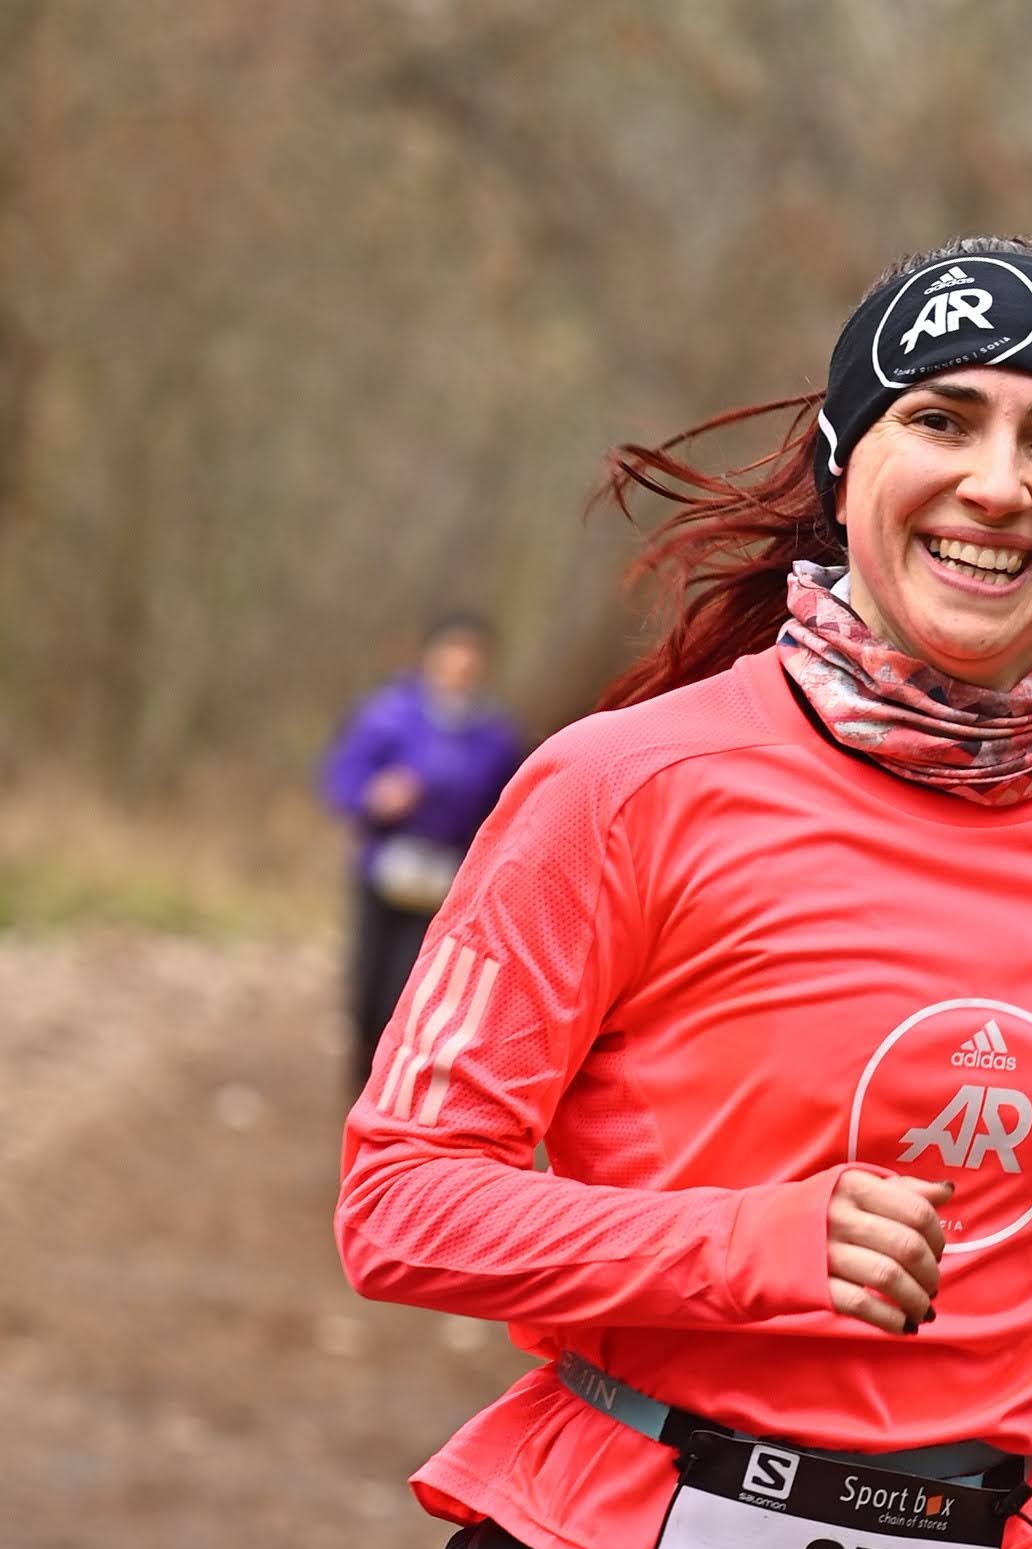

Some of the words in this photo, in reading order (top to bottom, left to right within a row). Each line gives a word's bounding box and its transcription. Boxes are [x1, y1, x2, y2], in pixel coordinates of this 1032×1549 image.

[923, 277, 975, 295] adidas
[951, 1051, 1017, 1071] adidas
[738, 1492, 787, 1511] salomon
[839, 1475, 909, 1512] Sport
[878, 1512, 905, 1526] chain
[906, 1515, 918, 1528] of
[919, 1517, 949, 1531] stores
